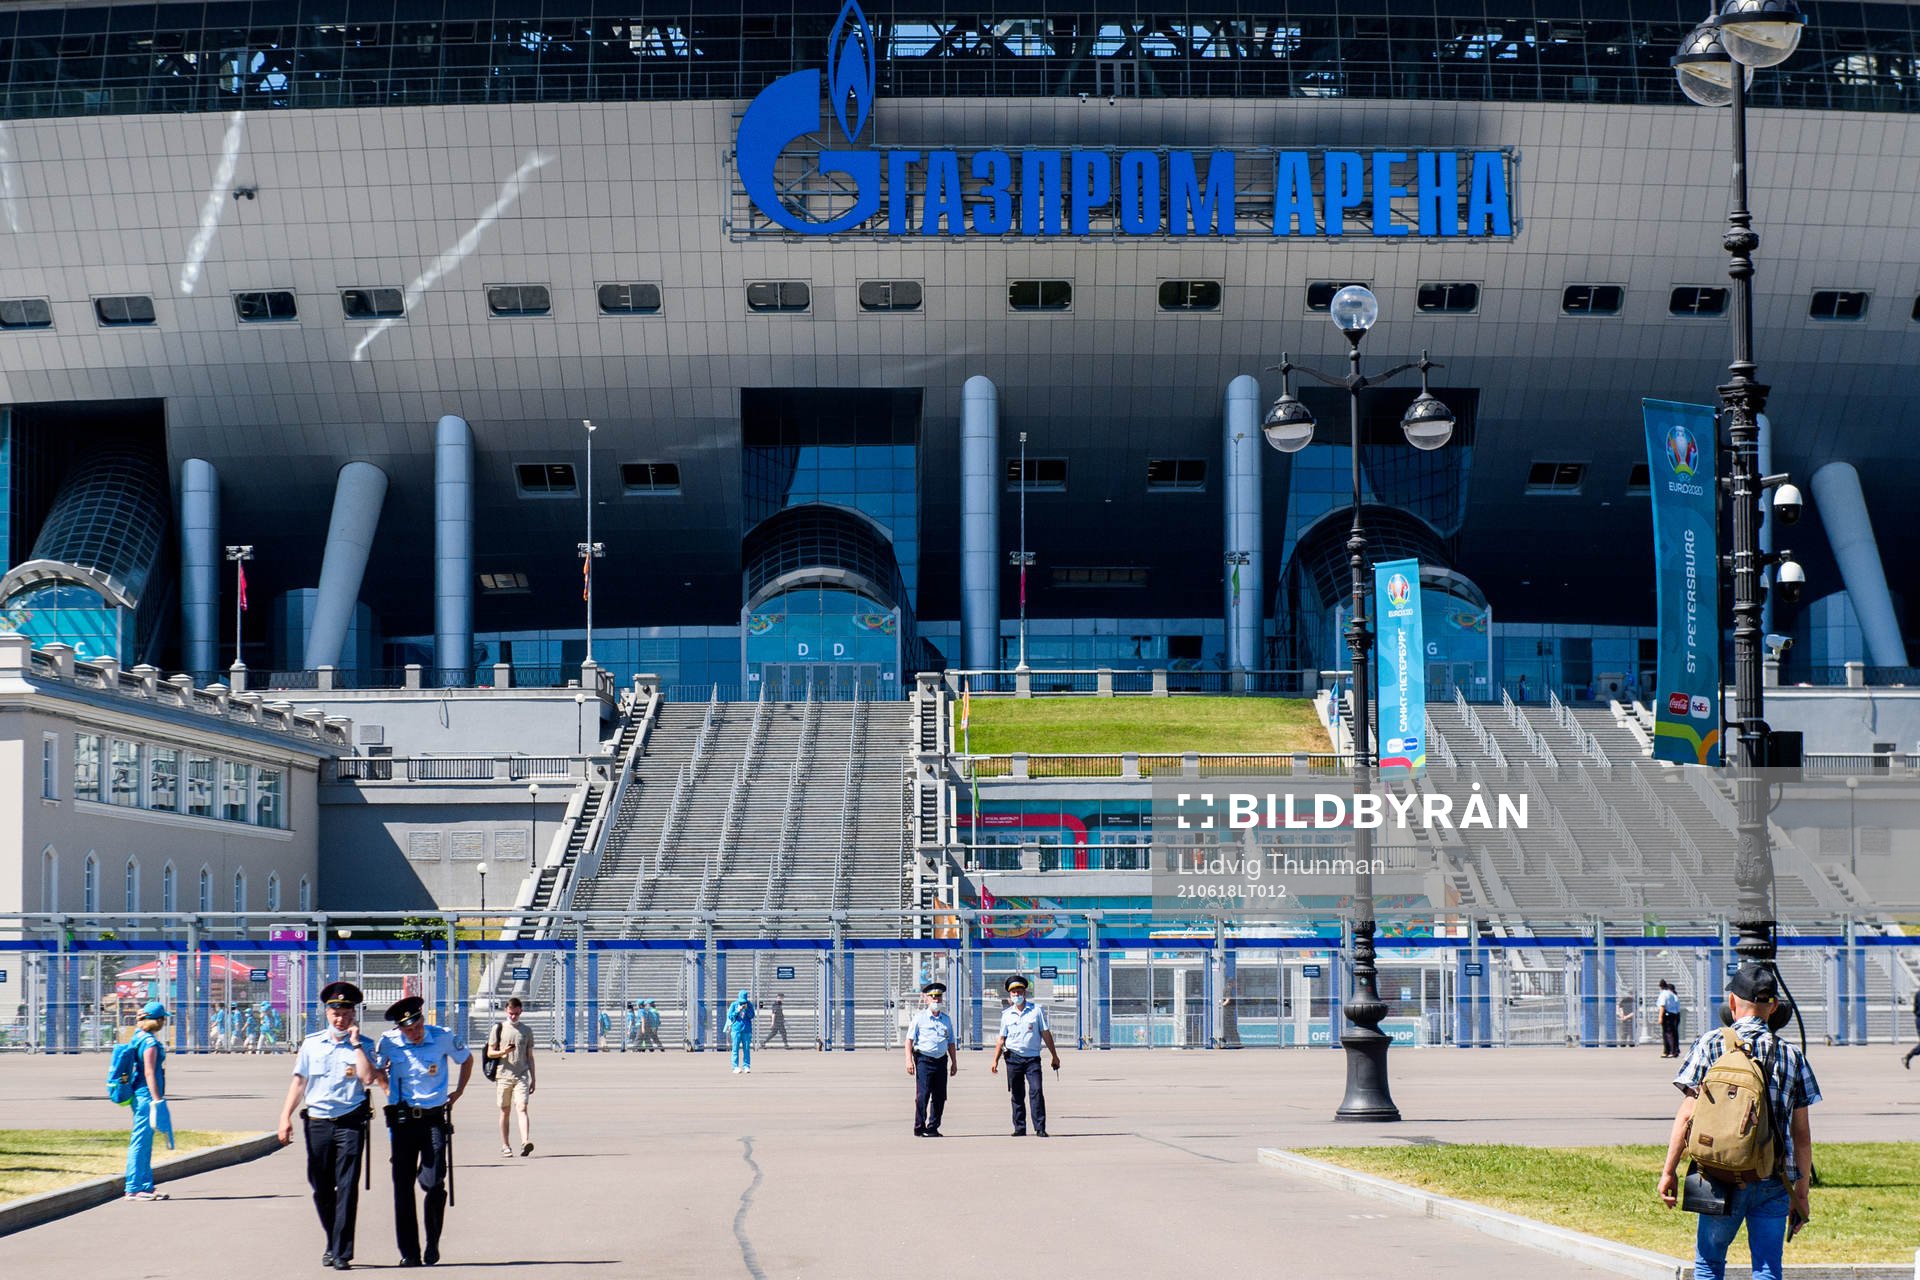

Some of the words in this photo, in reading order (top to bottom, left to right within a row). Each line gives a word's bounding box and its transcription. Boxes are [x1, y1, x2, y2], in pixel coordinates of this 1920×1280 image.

[886, 150, 1236, 236] ГАЗПРОМ
[1272, 151, 1512, 237] АРЕНА
[1668, 481, 1703, 496] EURO2020
[1684, 529, 1696, 647] PETERSBURG
[797, 643, 809, 656] D
[833, 643, 844, 656] D
[1426, 642, 1437, 655] G
[1687, 651, 1696, 673] ST
[1397, 628, 1408, 733] САНКТ-ПЕТЕРБУРГ
